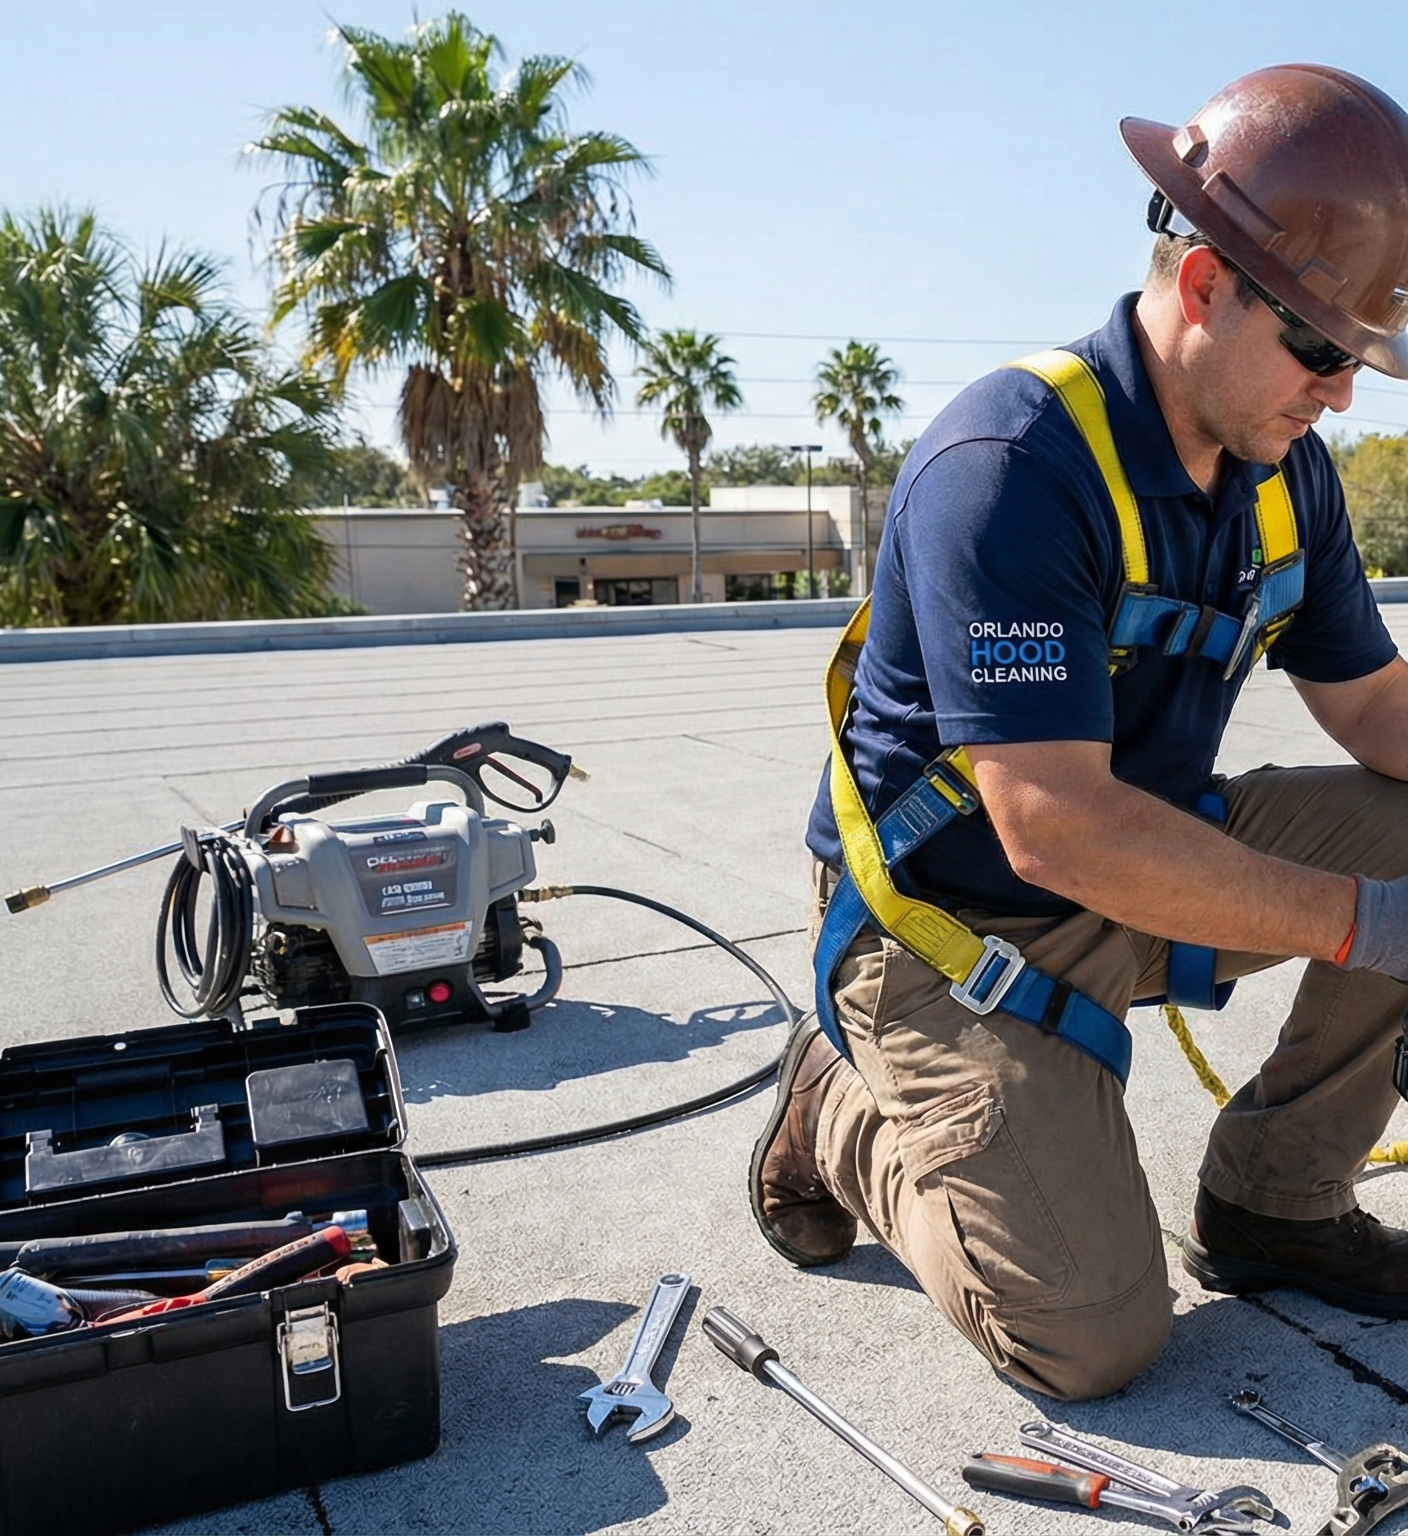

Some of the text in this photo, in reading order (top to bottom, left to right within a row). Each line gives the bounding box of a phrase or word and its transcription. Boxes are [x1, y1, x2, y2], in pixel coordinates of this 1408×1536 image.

[969, 622, 1064, 638] ORLANDO
[971, 640, 1066, 666] HOOD
[971, 666, 1068, 683] CLEANING
